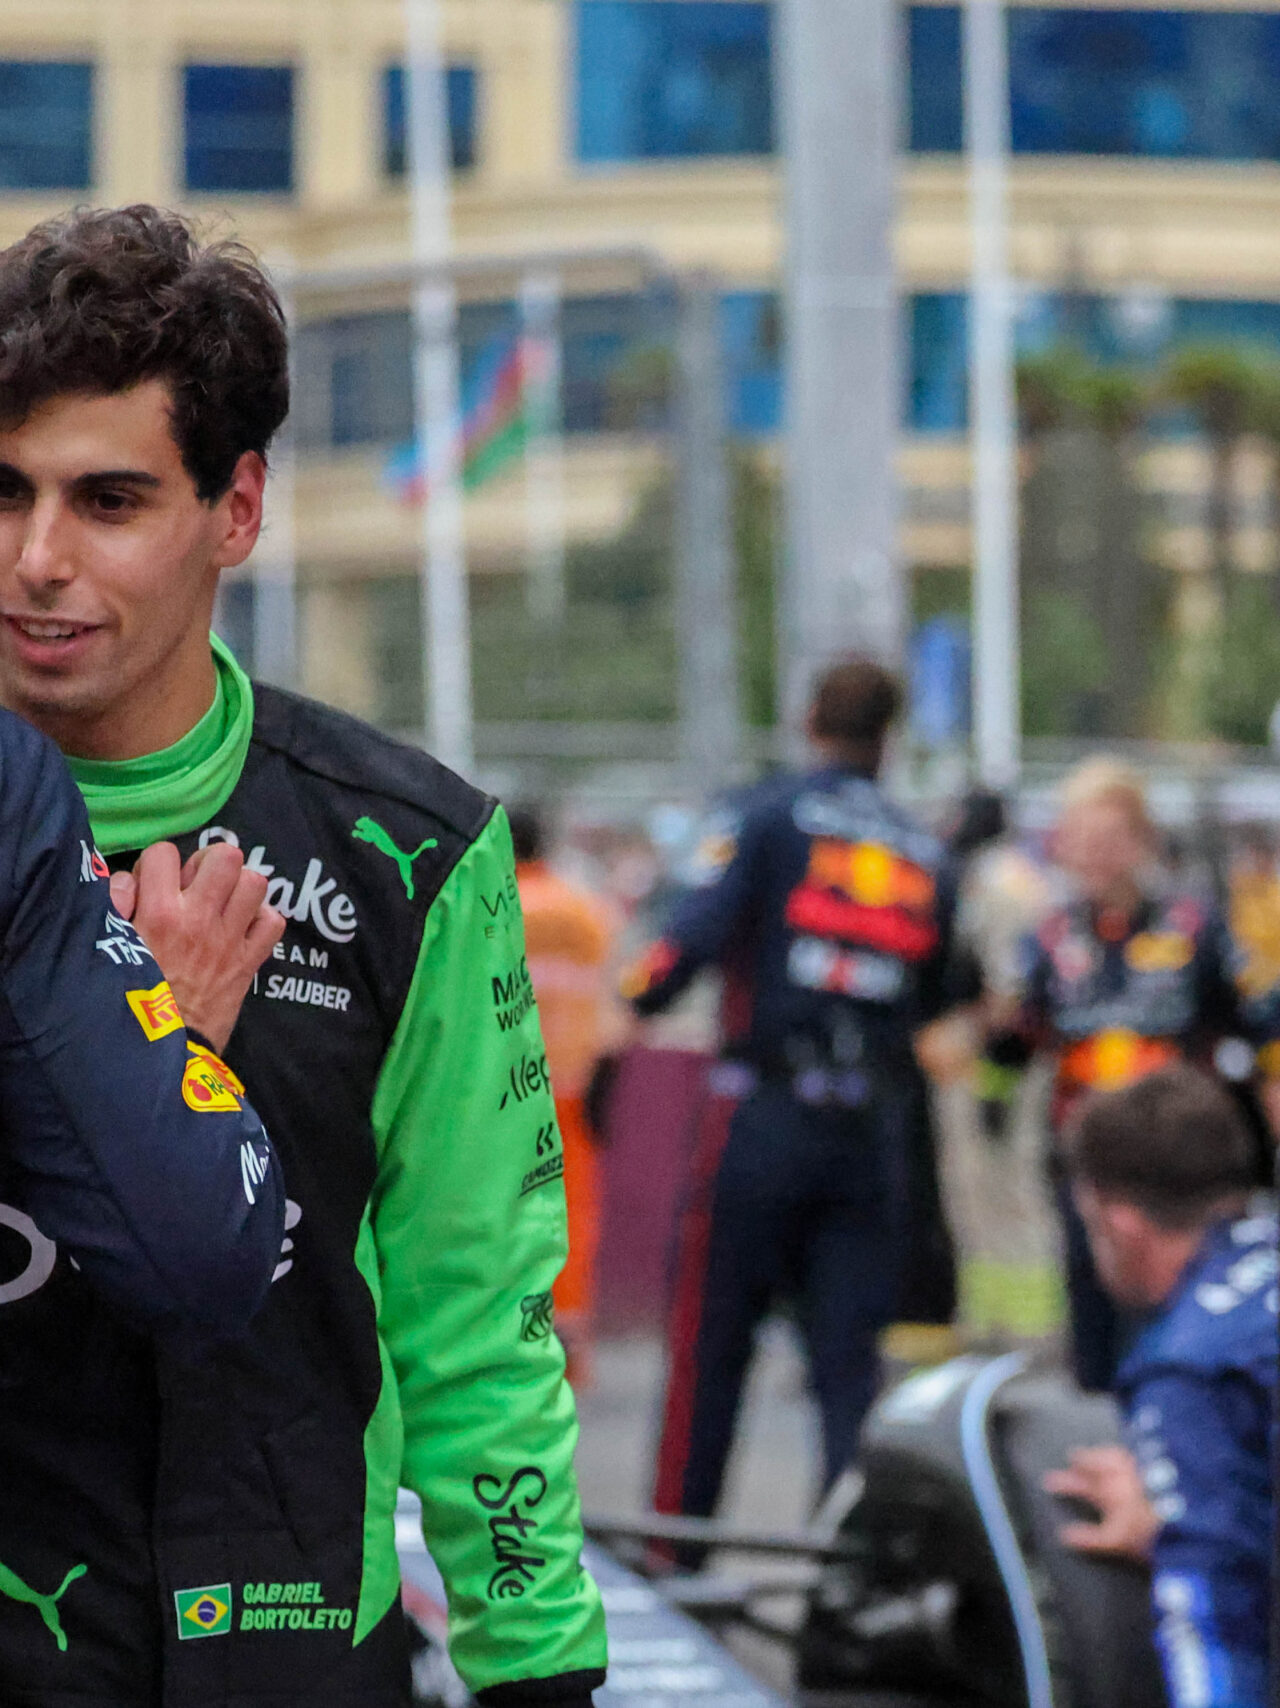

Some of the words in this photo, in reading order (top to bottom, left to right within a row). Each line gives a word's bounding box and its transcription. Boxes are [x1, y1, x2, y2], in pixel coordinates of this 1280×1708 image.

[198, 826, 358, 943] take
[273, 942, 329, 969] EAM
[264, 974, 352, 1012] SAUBER
[473, 1466, 547, 1600] Stake
[242, 1582, 325, 1604] GABRIEL
[239, 1607, 353, 1631] BORTOLETO
